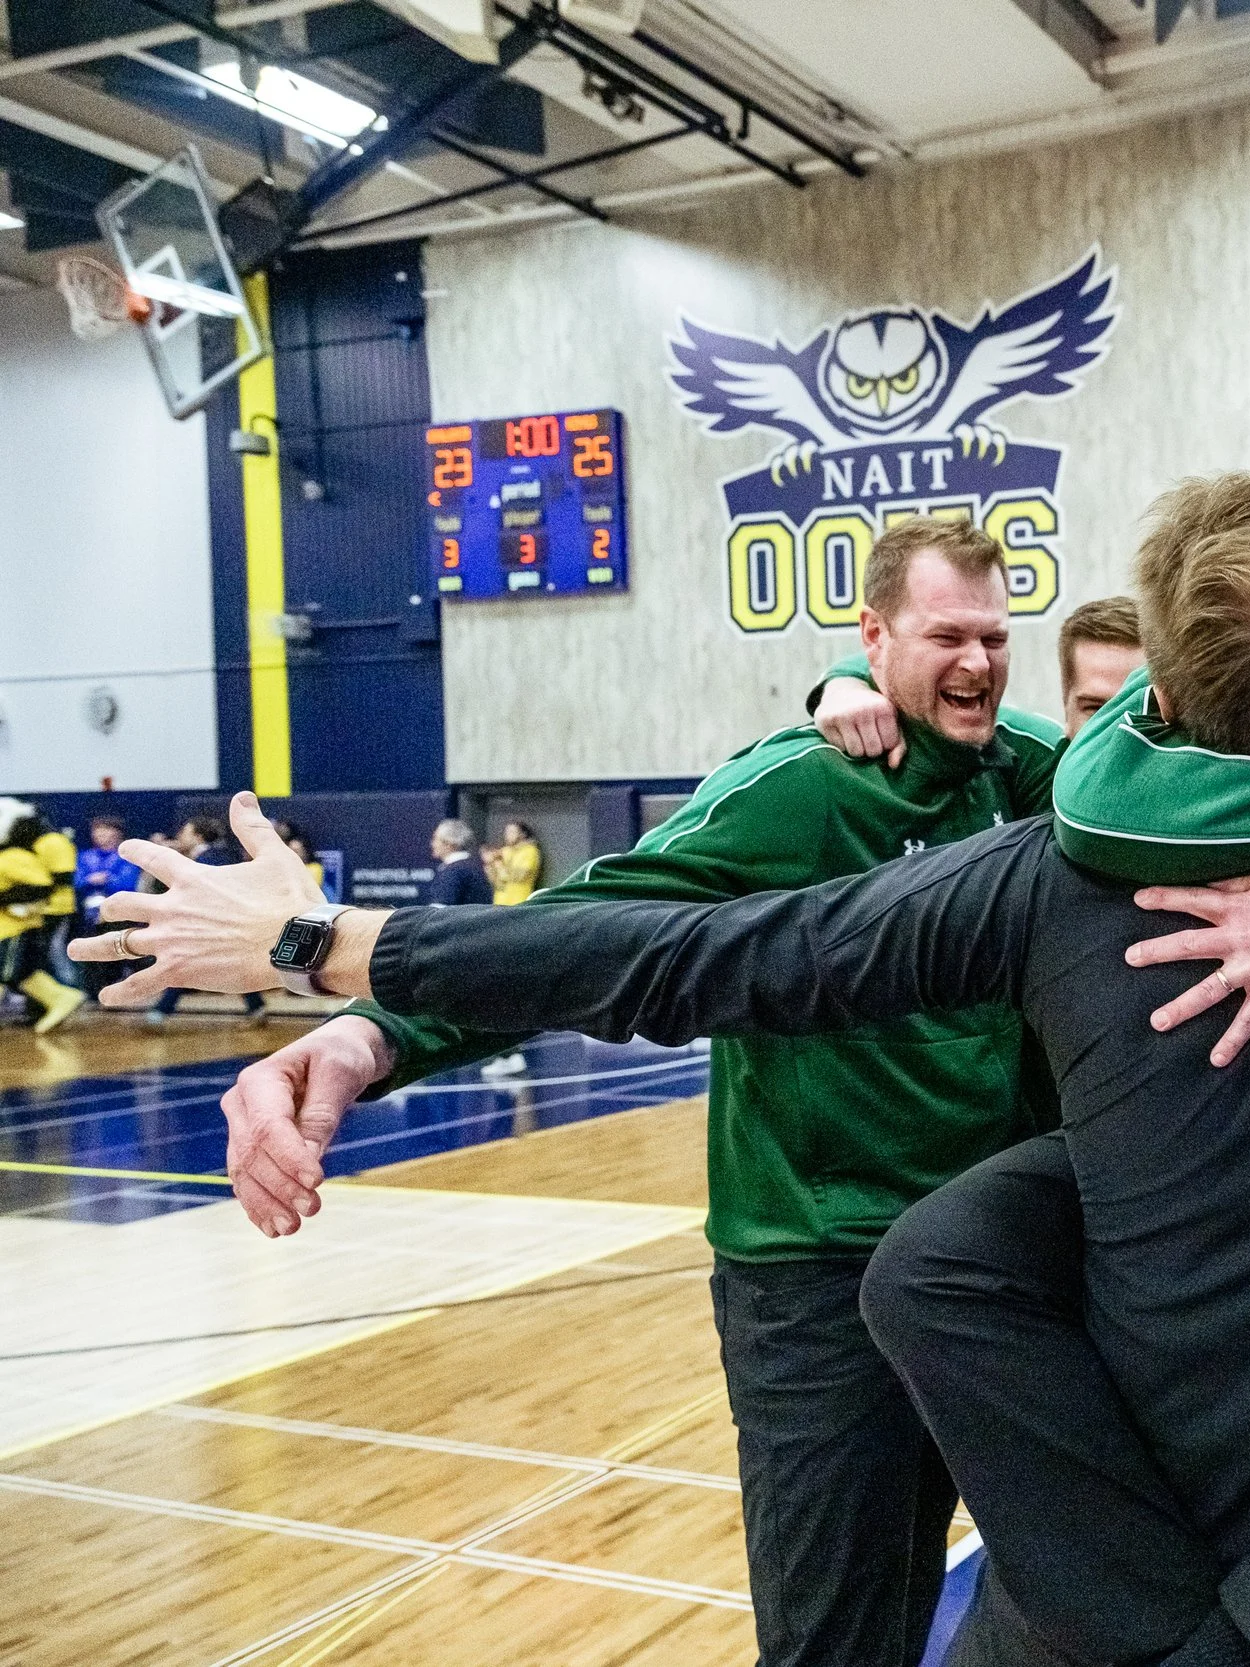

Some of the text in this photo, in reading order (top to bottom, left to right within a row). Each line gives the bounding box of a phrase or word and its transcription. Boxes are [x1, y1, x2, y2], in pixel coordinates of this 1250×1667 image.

[506, 415, 560, 457] 1:00
[573, 435, 613, 477] 25
[434, 448, 473, 488] 23
[822, 447, 954, 501] NAIT
[443, 538, 460, 568] 3
[519, 533, 536, 564] 3
[592, 528, 610, 559] 2
[727, 493, 1060, 633] OOS
